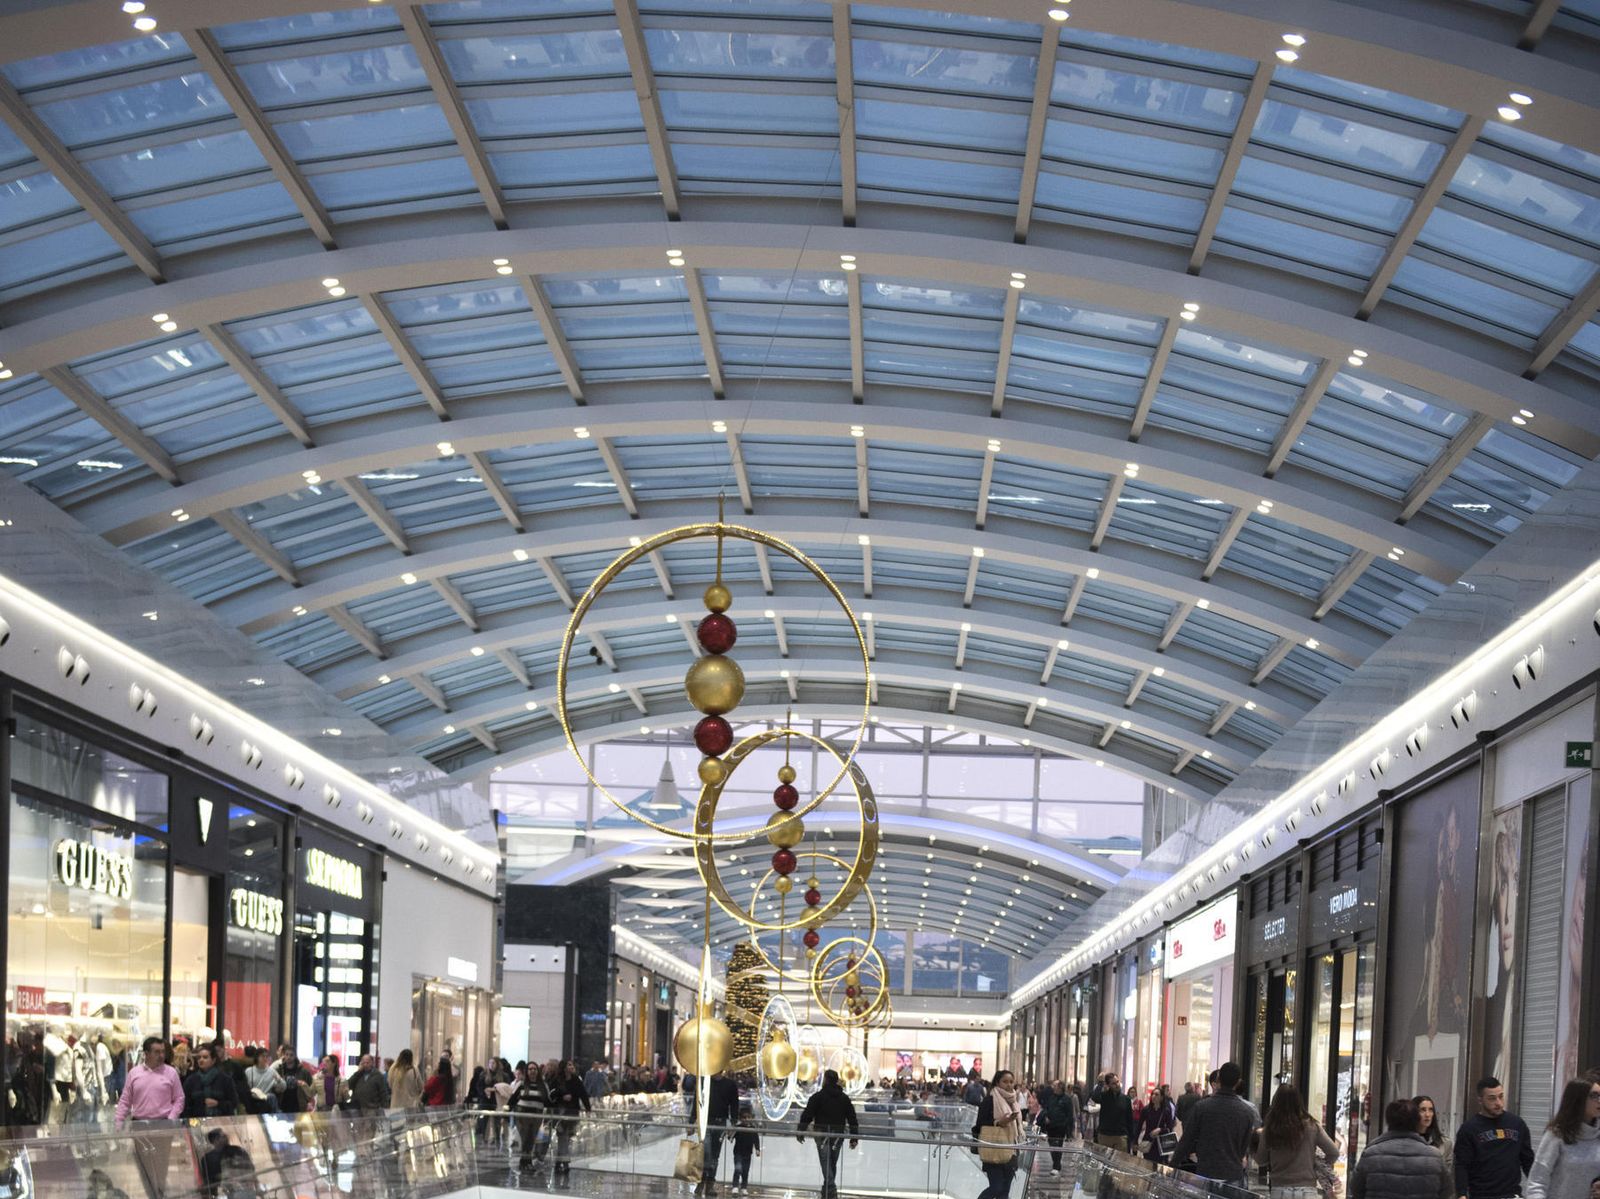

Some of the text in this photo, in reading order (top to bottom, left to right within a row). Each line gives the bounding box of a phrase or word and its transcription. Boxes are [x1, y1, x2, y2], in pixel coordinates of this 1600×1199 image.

[57, 838, 133, 900] GUESS
[231, 888, 283, 936] GUESS
[1329, 887, 1358, 915] VERO MODA
